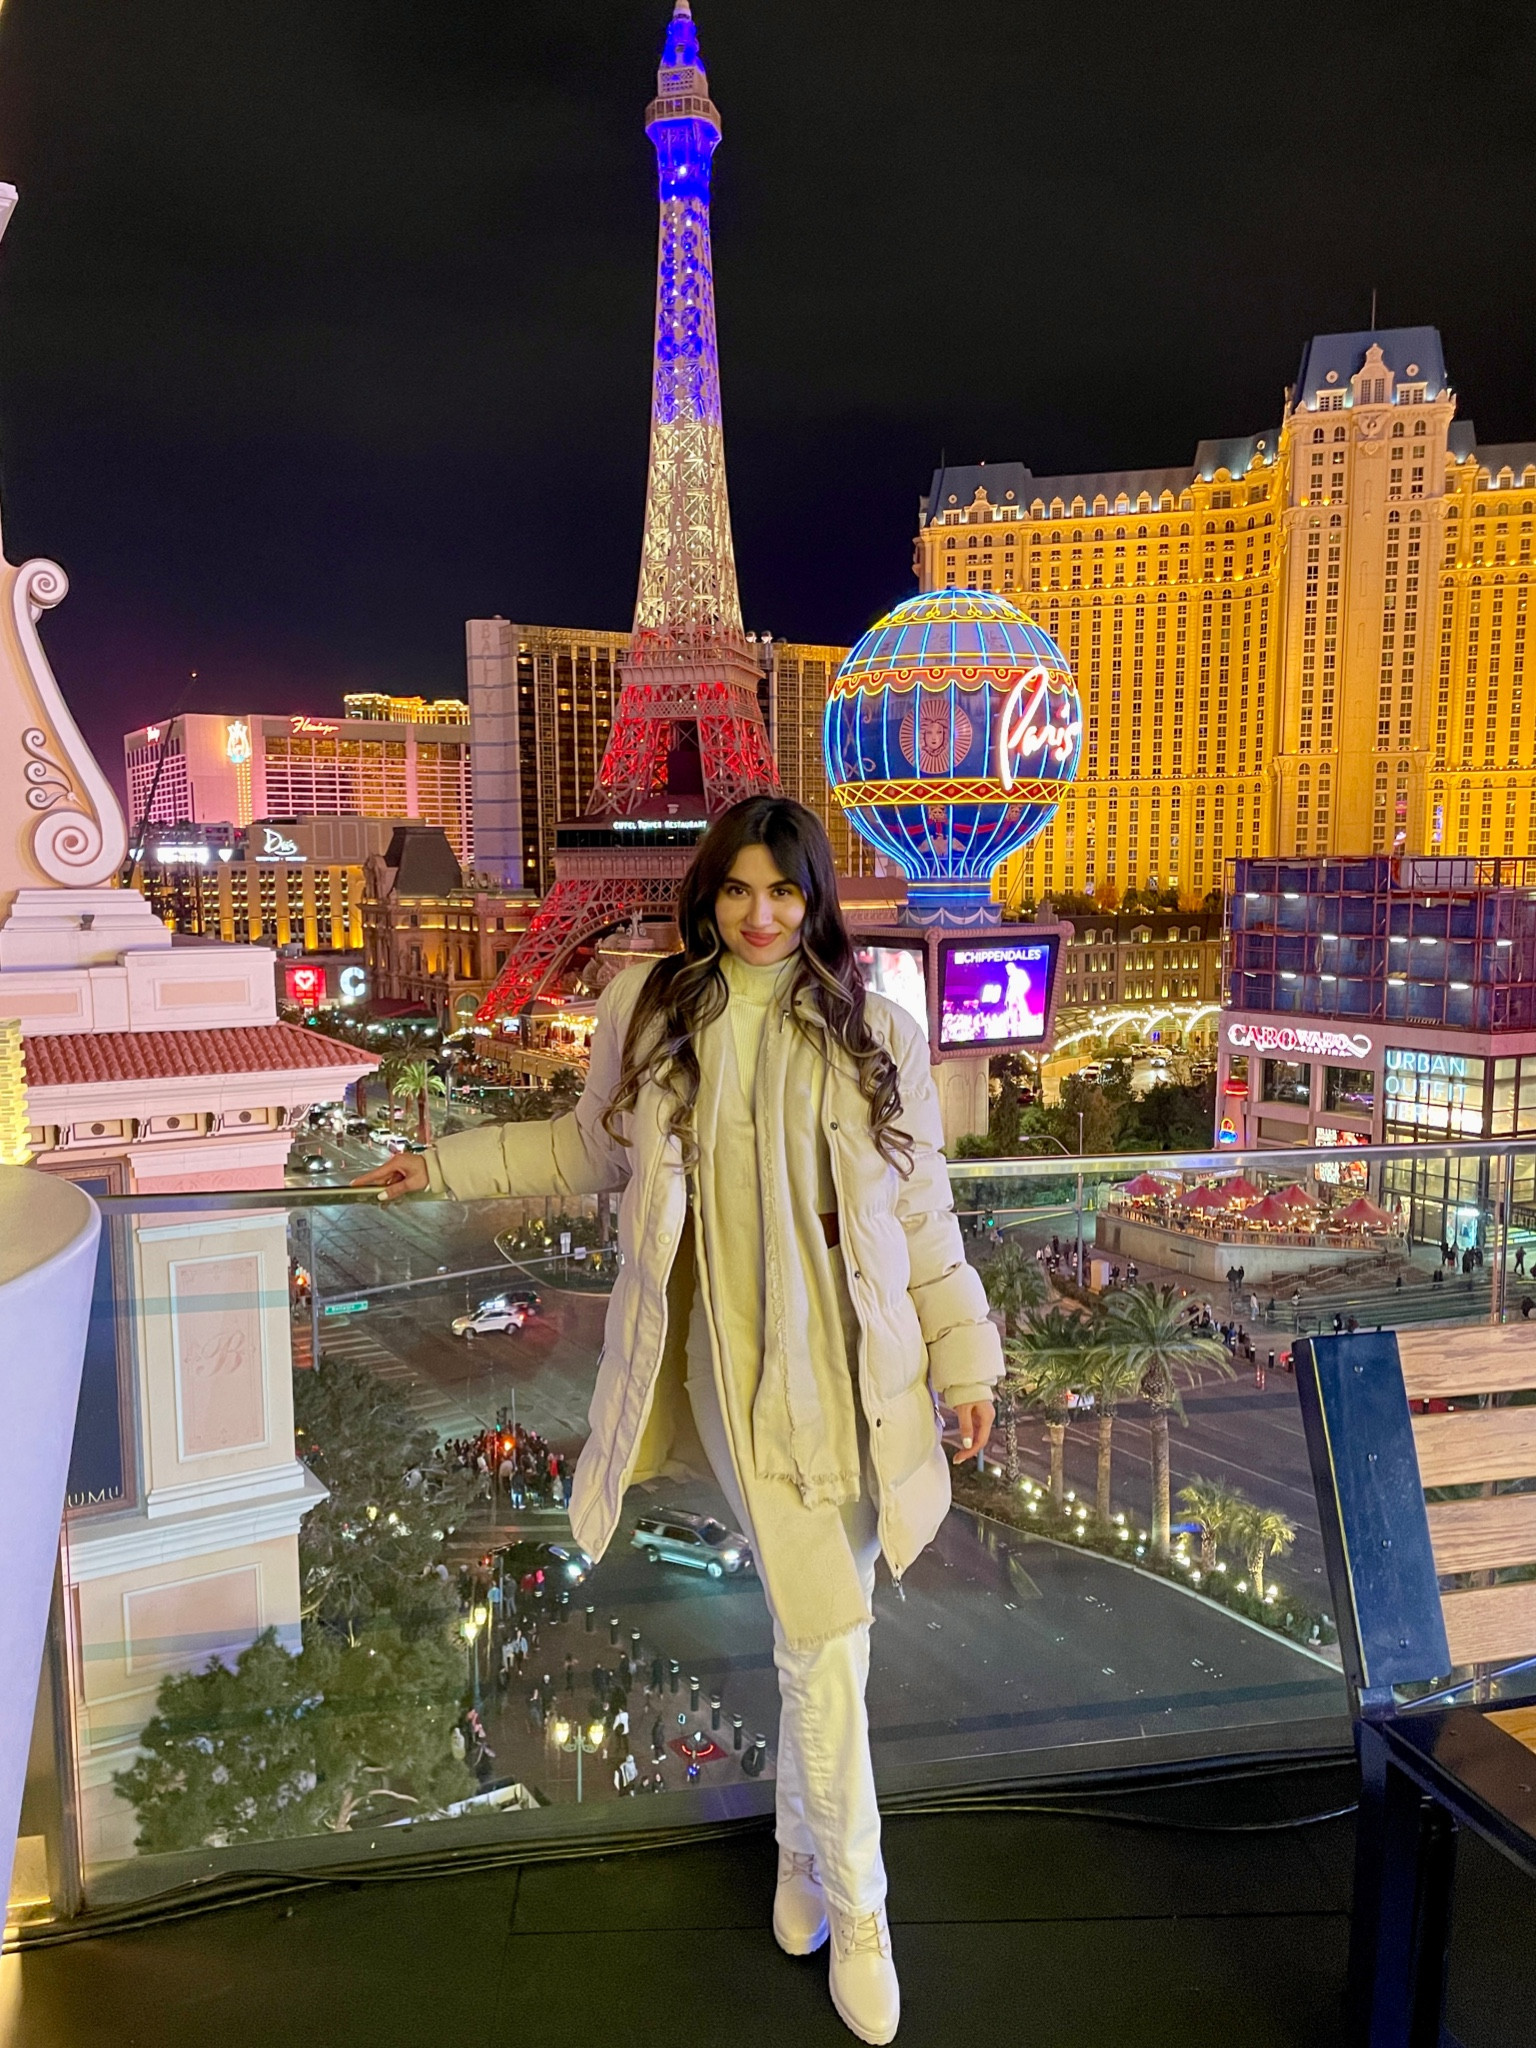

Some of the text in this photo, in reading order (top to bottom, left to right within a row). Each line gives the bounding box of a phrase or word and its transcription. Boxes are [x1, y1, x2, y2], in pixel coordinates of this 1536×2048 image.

[290, 716, 340, 735] Flamingo
[1000, 665, 1082, 790] Paris
[664, 820, 708, 829] RESTAURANT
[963, 949, 1042, 964] CHIPPENDALES
[1227, 1023, 1297, 1052] CABO
[1386, 1050, 1465, 1077] URBAN
[1385, 1075, 1467, 1104] OUTFIT
